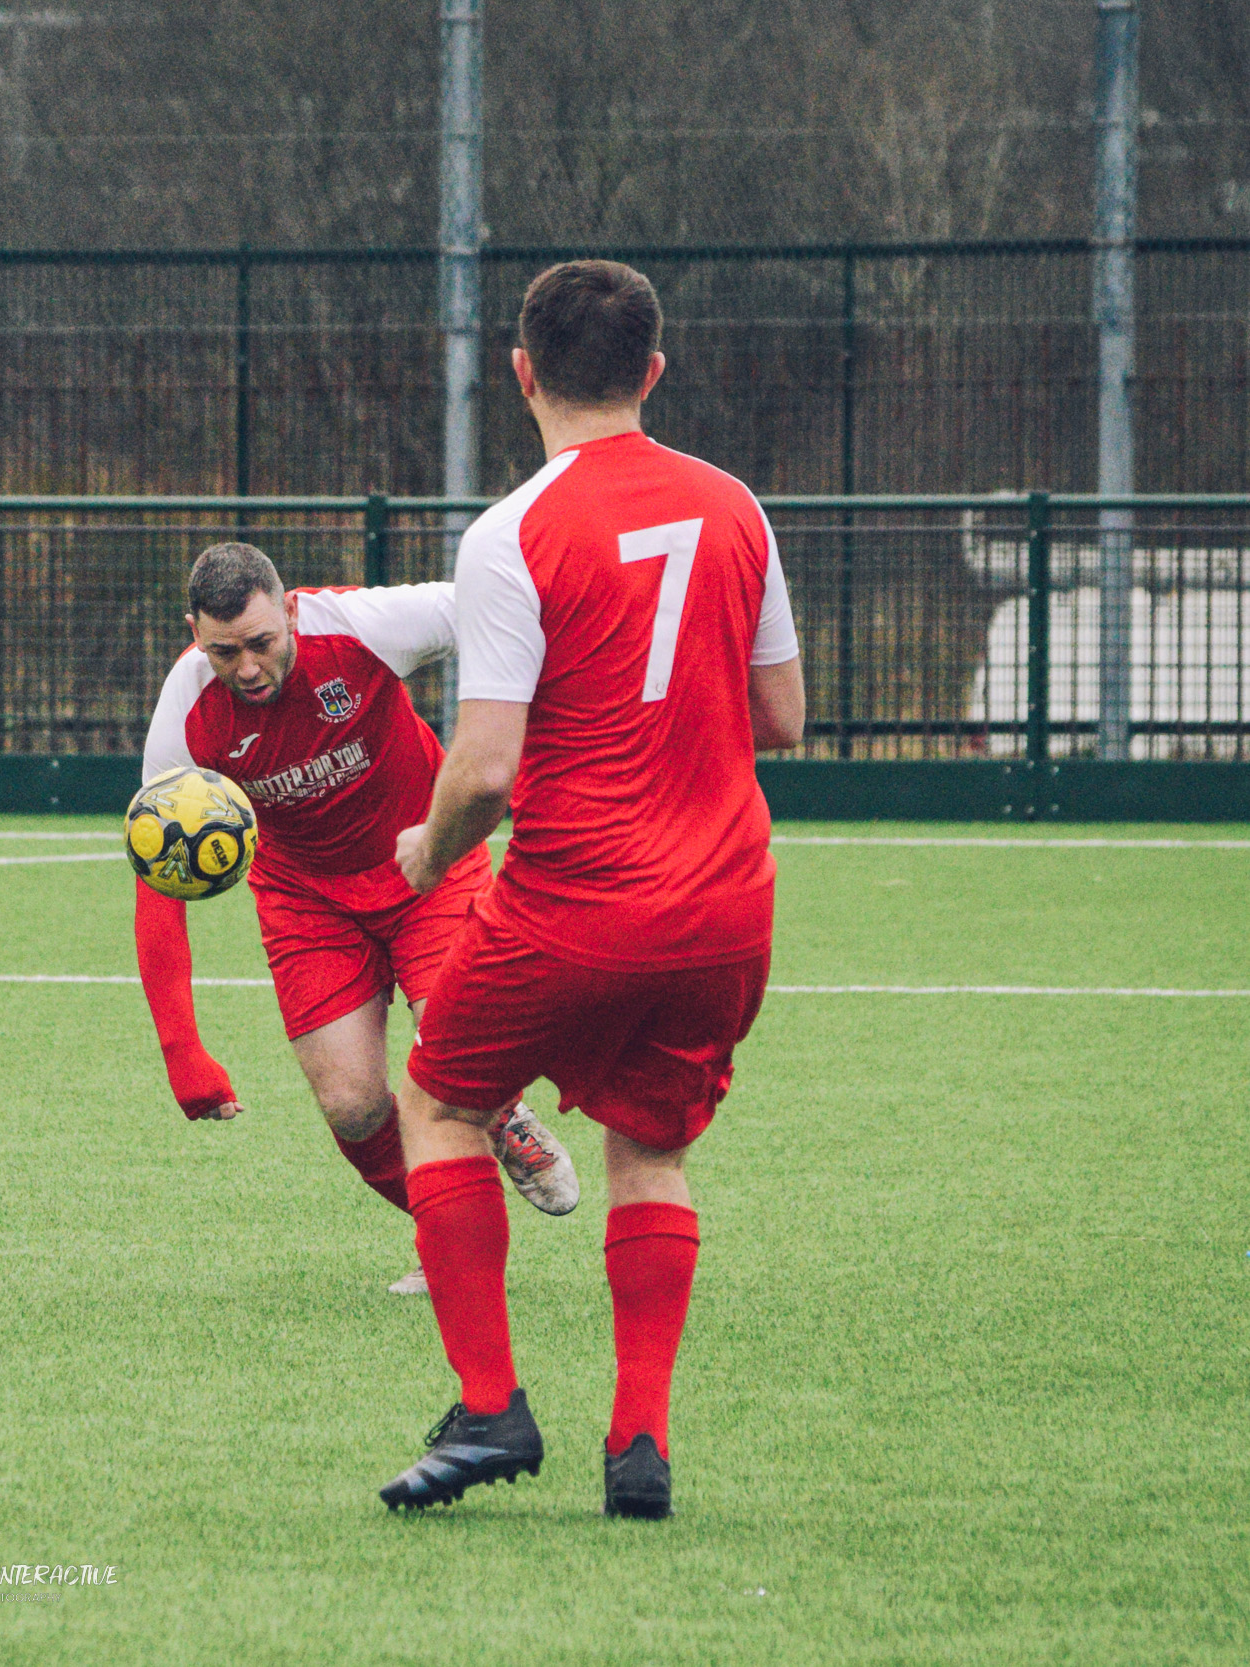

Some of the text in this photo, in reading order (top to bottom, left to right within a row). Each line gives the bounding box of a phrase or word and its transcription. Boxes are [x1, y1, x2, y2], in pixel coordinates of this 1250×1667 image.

[618, 518, 704, 702] 7
[304, 754, 335, 782] FOR
[210, 839, 229, 869] DELTA
